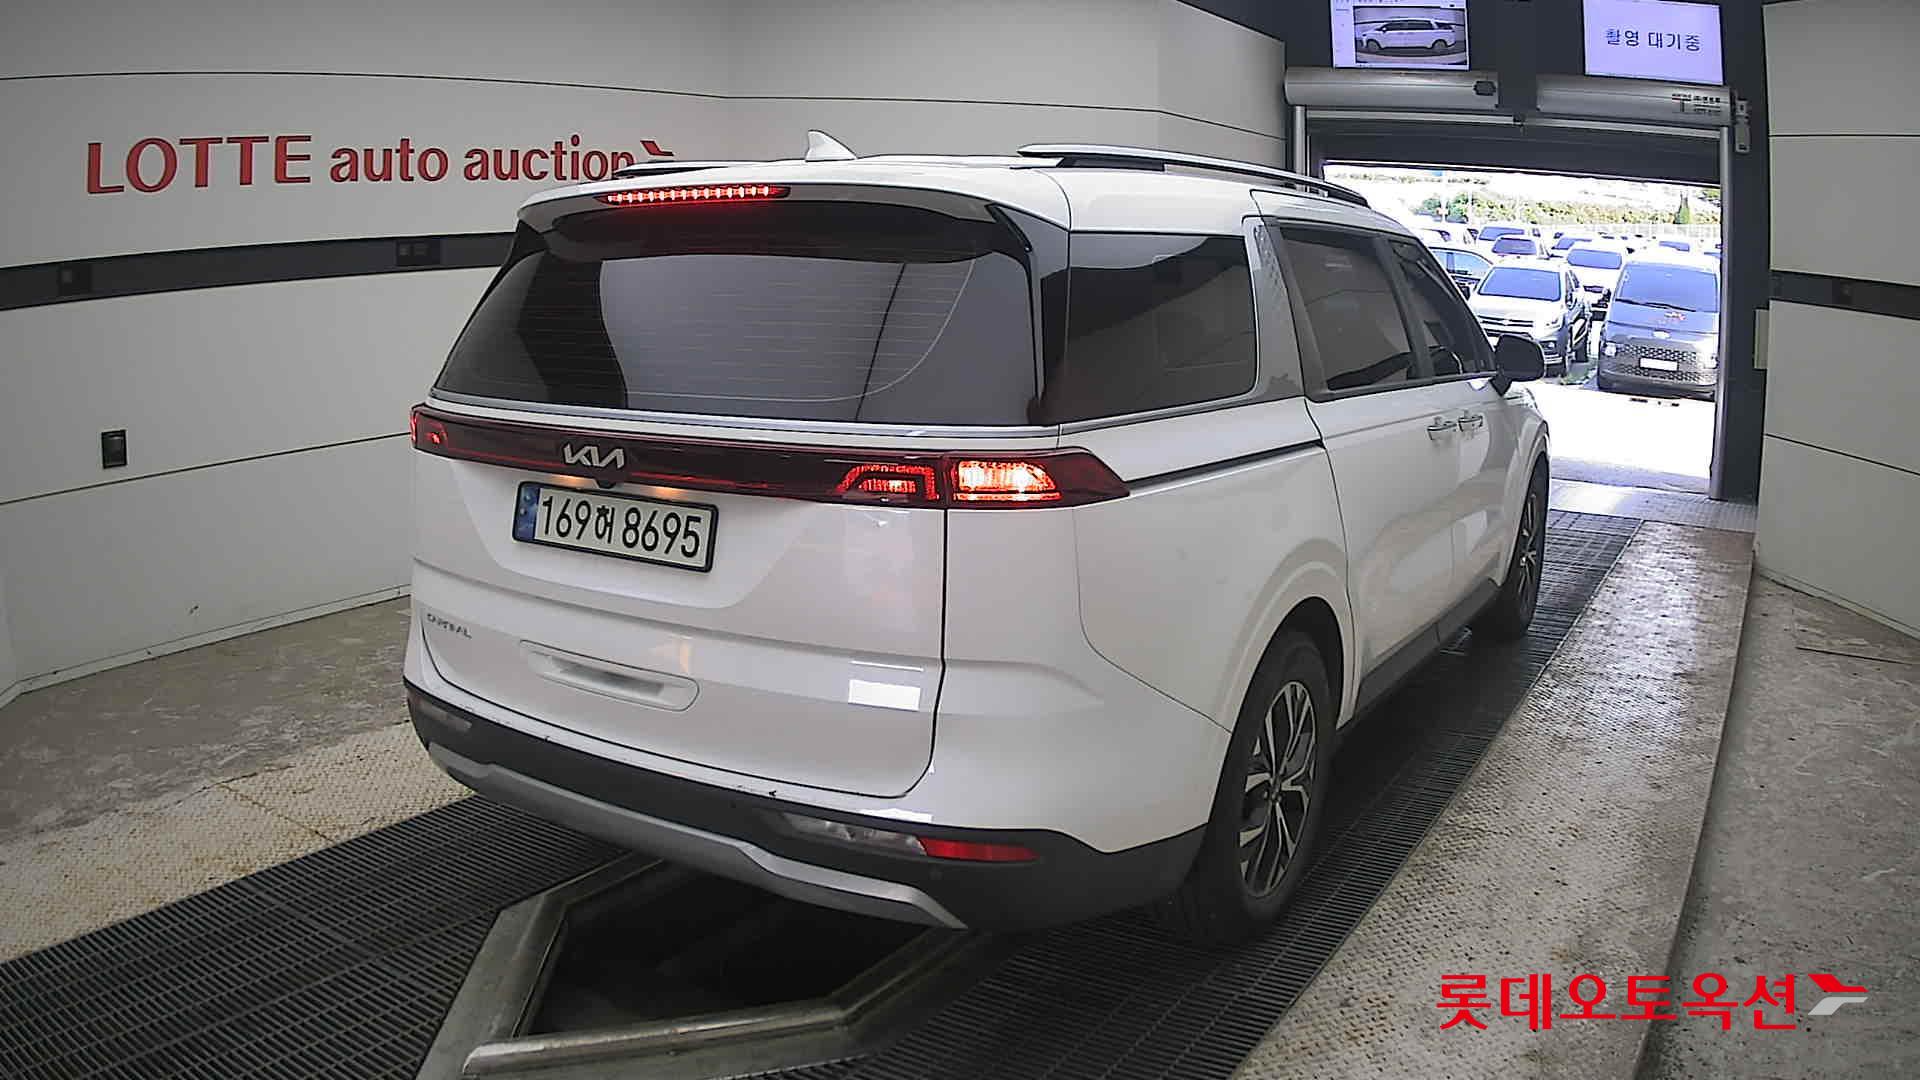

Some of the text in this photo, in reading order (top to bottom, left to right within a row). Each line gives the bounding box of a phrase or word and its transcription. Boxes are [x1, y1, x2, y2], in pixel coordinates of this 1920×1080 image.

[1647, 32, 1700, 52] 대기중
[87, 134, 635, 195] LOTTE auto auction
[563, 443, 625, 469] KIA
[542, 495, 702, 558] 169허 8695
